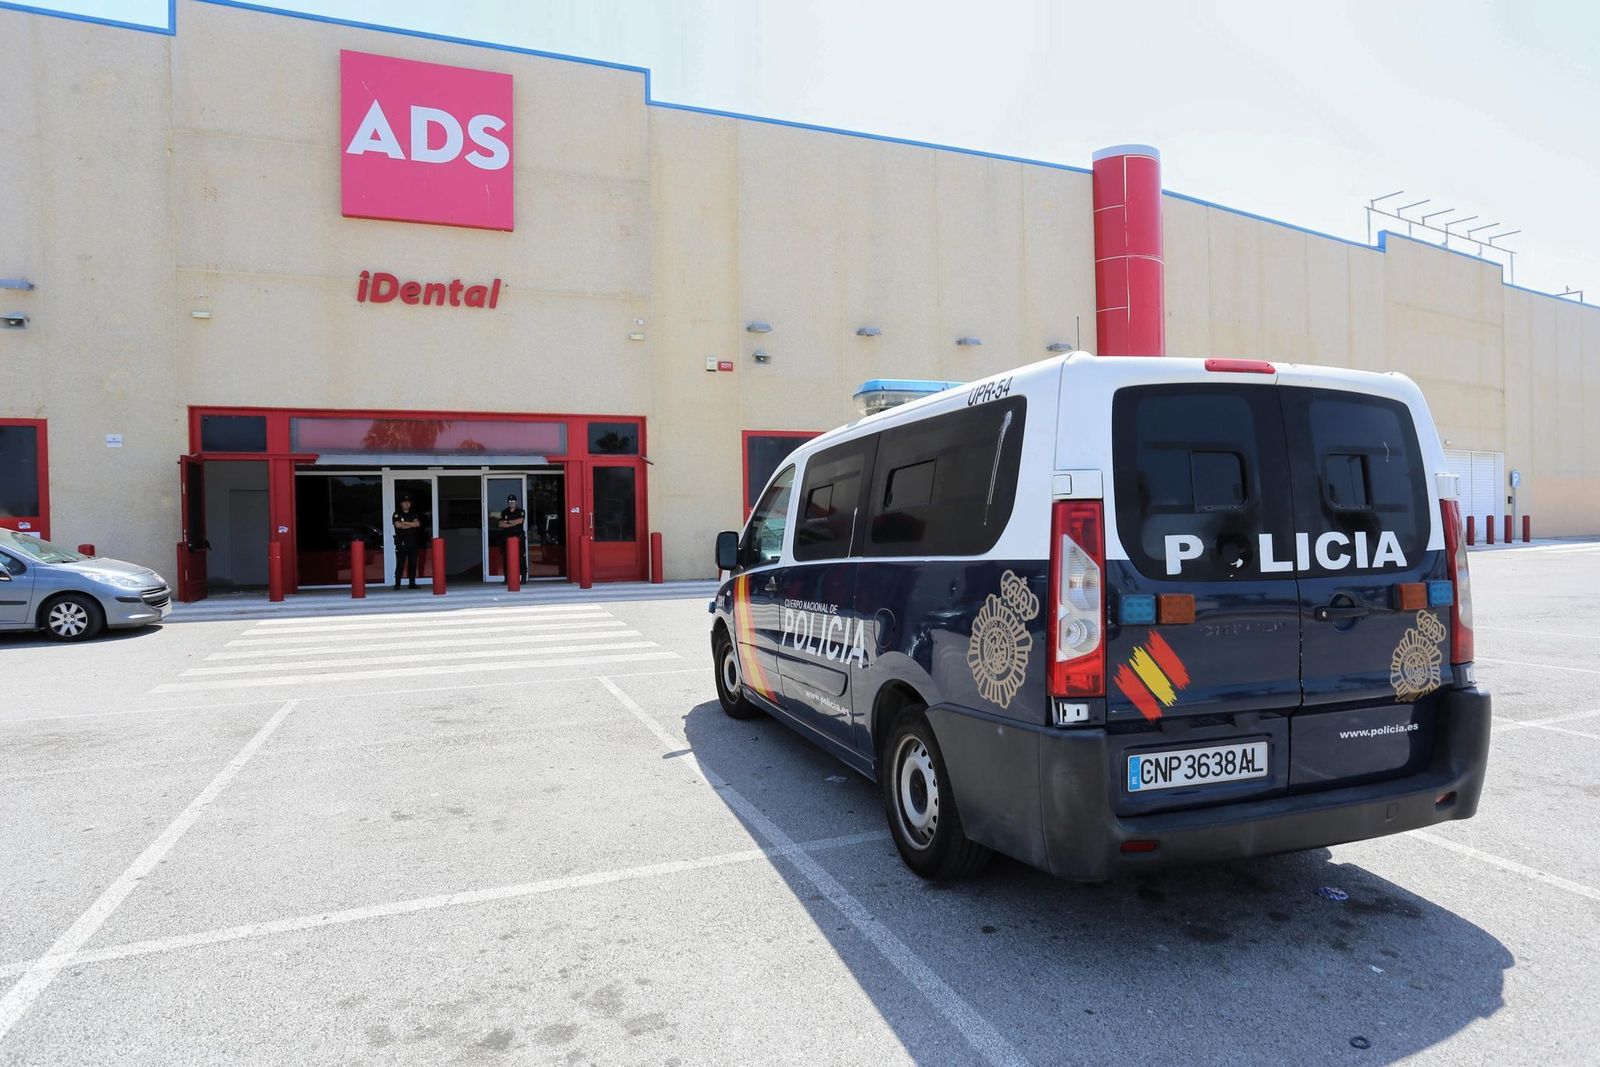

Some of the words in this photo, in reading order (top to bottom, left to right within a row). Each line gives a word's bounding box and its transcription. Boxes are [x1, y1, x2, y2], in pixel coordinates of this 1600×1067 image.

[346, 99, 510, 170] ADS
[357, 270, 501, 309] iDental
[968, 376, 1013, 406] UPR-54
[1164, 531, 1407, 575] PLICIA
[784, 599, 803, 609] CUERPO
[804, 601, 829, 613] NACIONAL
[829, 604, 838, 614] DE
[781, 608, 864, 668] POLICIA
[1339, 723, 1419, 739] www.policia.es
